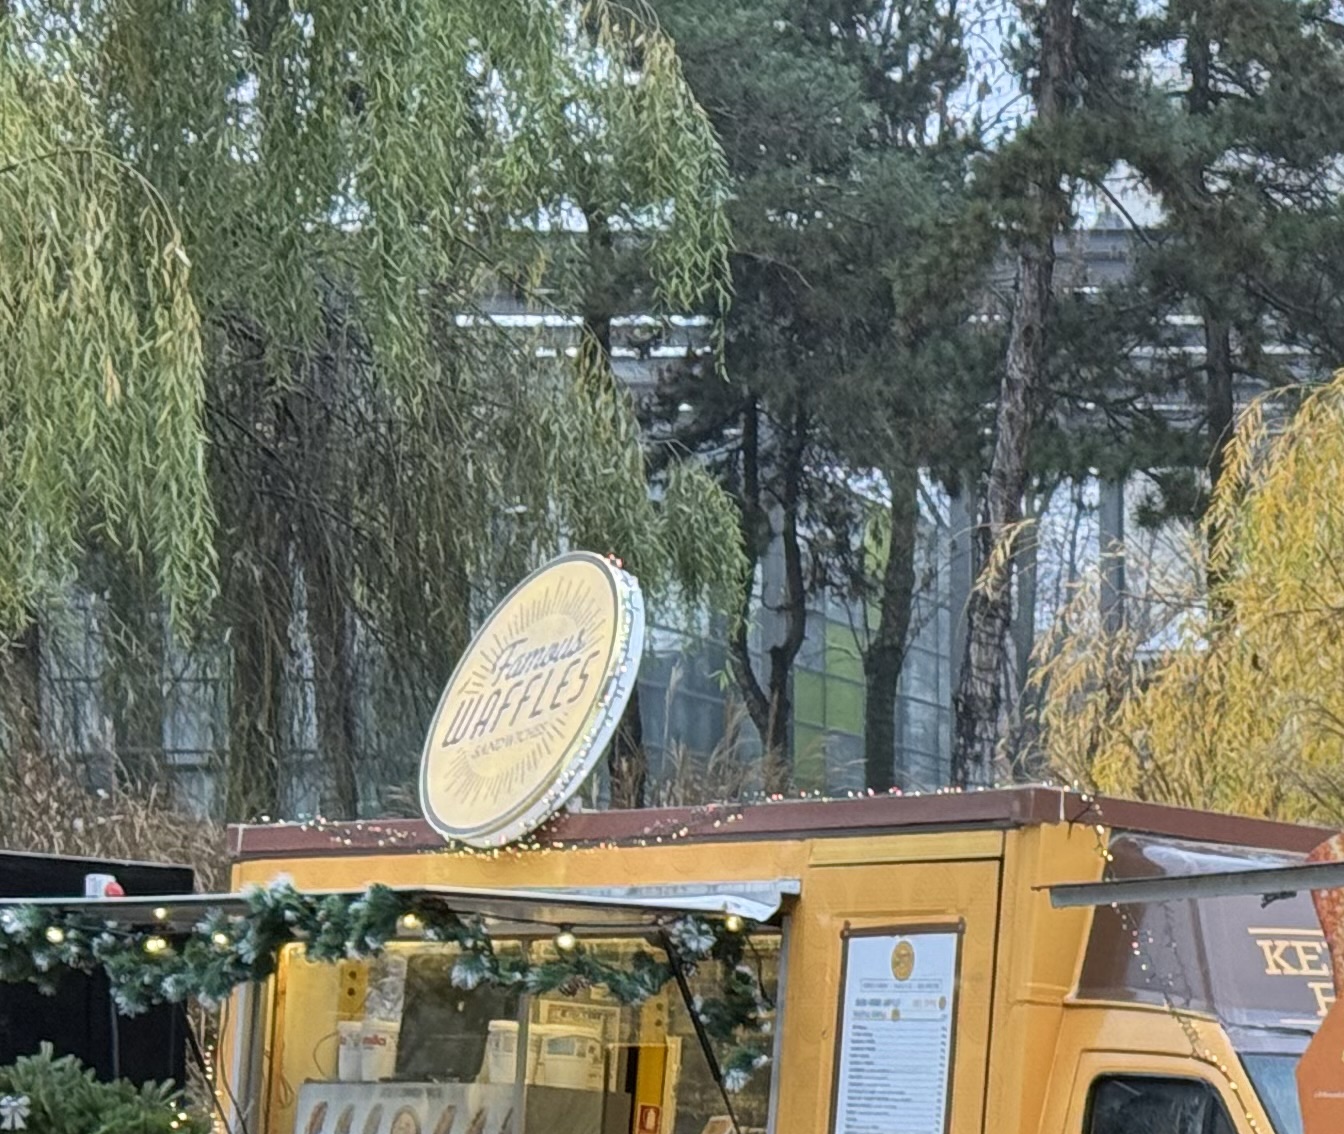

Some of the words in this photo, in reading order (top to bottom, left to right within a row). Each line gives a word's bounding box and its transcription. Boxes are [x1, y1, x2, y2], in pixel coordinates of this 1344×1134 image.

[491, 627, 587, 687] Famous
[441, 650, 601, 749] WAFFLES
[1256, 938, 1332, 976] KE
